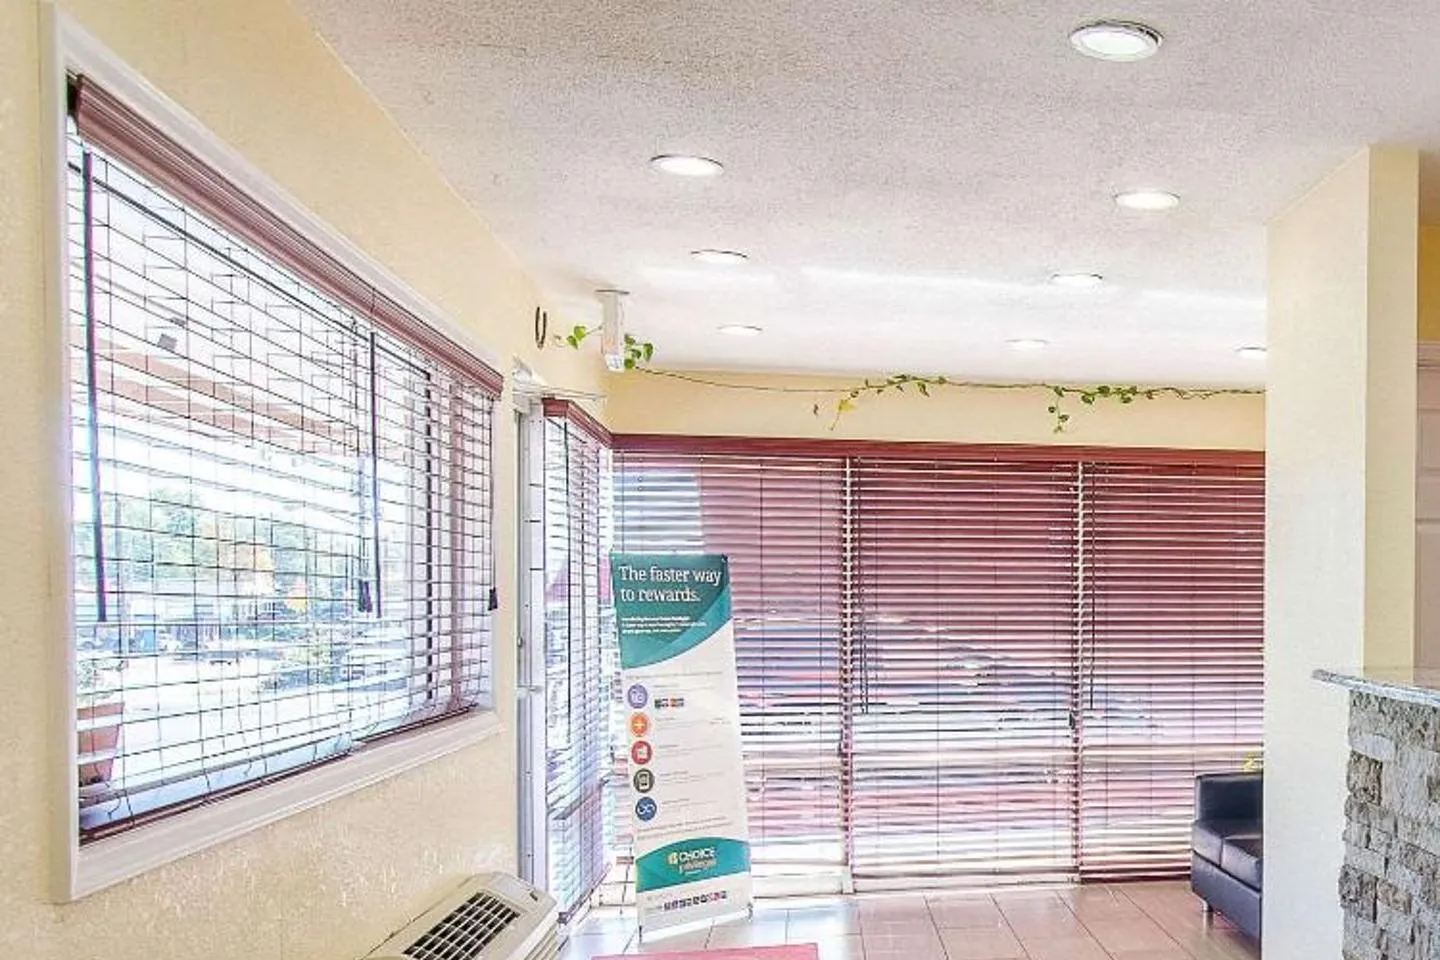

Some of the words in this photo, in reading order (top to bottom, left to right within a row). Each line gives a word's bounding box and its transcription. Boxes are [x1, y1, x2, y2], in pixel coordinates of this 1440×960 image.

[618, 564, 648, 582] The
[650, 565, 691, 583] faster
[692, 569, 722, 586] way
[620, 588, 635, 602] to
[638, 587, 701, 602] rewards.
